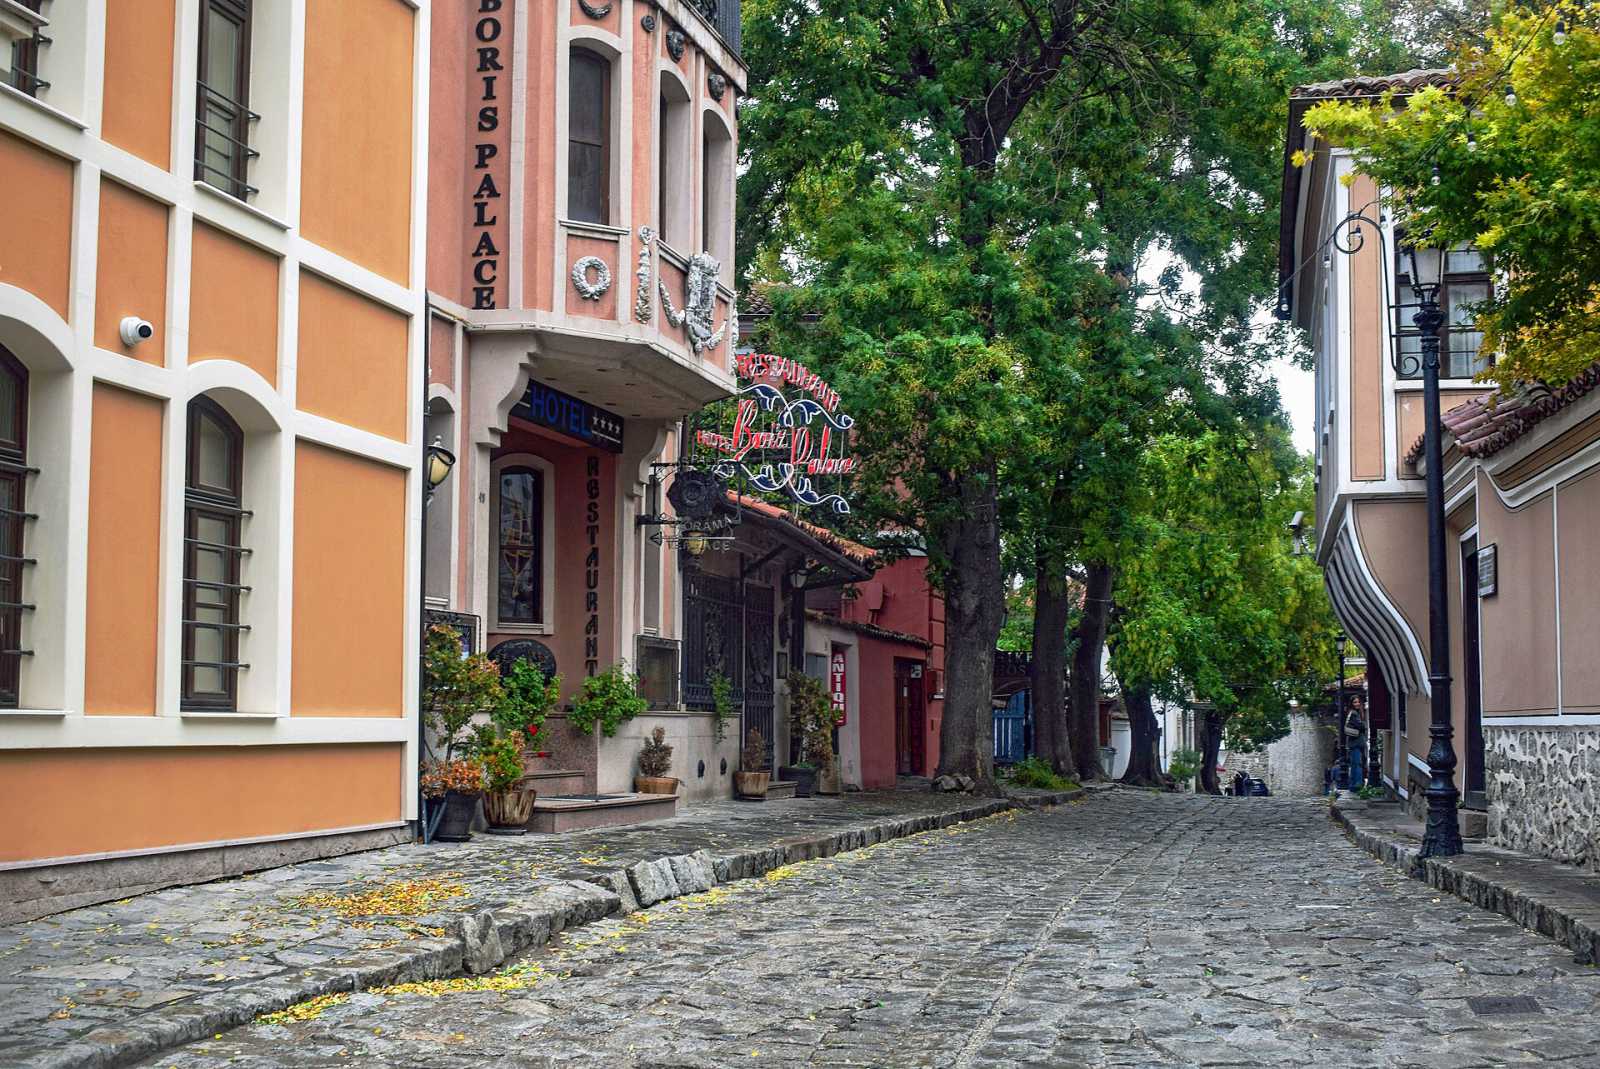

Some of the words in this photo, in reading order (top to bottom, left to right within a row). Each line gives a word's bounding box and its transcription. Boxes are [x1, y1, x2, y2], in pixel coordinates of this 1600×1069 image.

[476, 0, 504, 132] BORIS
[472, 144, 501, 310] PALACE
[530, 383, 593, 438] HOTEL
[585, 456, 599, 677] RESTAURANT
[832, 653, 845, 723] ANTIQU
